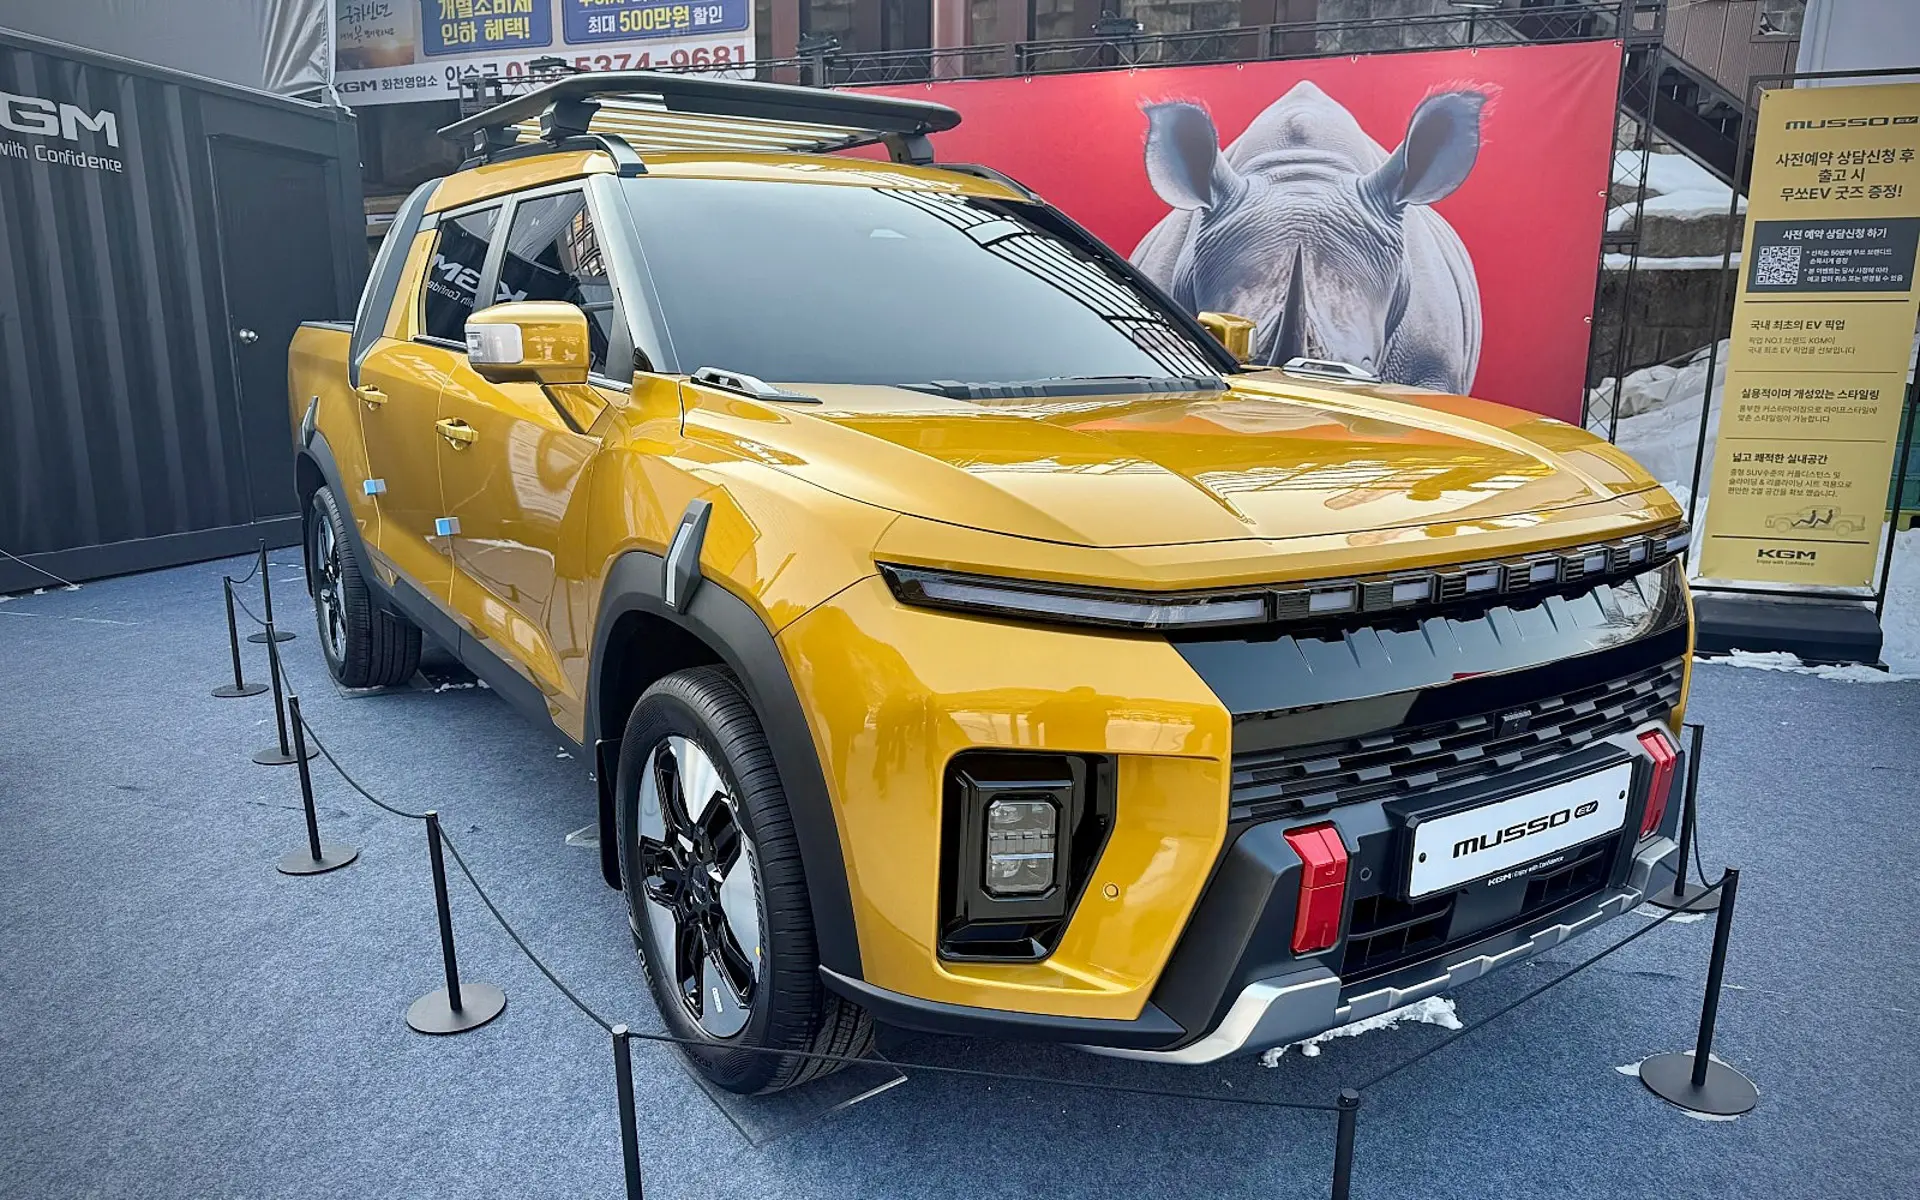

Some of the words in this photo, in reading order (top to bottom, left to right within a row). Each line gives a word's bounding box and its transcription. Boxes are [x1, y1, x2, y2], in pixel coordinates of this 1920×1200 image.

[439, 0, 532, 21] 개별소비세
[588, 15, 615, 34] 최대
[619, 5, 690, 32] 500만원
[692, 6, 723, 26] 할인
[441, 22, 477, 46] 인하
[484, 17, 530, 42] 혜택!
[381, 75, 438, 91] 화천영업소
[34, 144, 122, 173] Confidence
[1775, 151, 1833, 168] 사전예약
[1836, 149, 1896, 166] 상담신청
[1899, 148, 1915, 163] 후
[1818, 169, 1847, 184] 출고
[1850, 167, 1865, 182] 시
[1780, 187, 1831, 201] 무쏘EV
[1835, 186, 1864, 200] 굿즈
[1868, 184, 1903, 199] 증정!
[1782, 229, 1803, 240] 사전
[1804, 229, 1824, 240] 예약
[1826, 228, 1865, 240] 상담신청
[1866, 227, 1887, 239] 하기
[1750, 319, 1771, 331] 국내
[1772, 319, 1803, 331] 최초의
[1805, 320, 1822, 330] EV
[1825, 319, 1845, 331] 픽업
[1741, 388, 1791, 399] 실용적이며
[1793, 388, 1835, 400] 개성있는
[1836, 389, 1880, 400] 스타일링
[1732, 452, 1752, 463] 넓고
[1753, 453, 1784, 464] 쾌적한
[1786, 453, 1828, 465] 실내공간
[1757, 549, 1817, 560] KGM
[1575, 801, 1598, 818] EV
